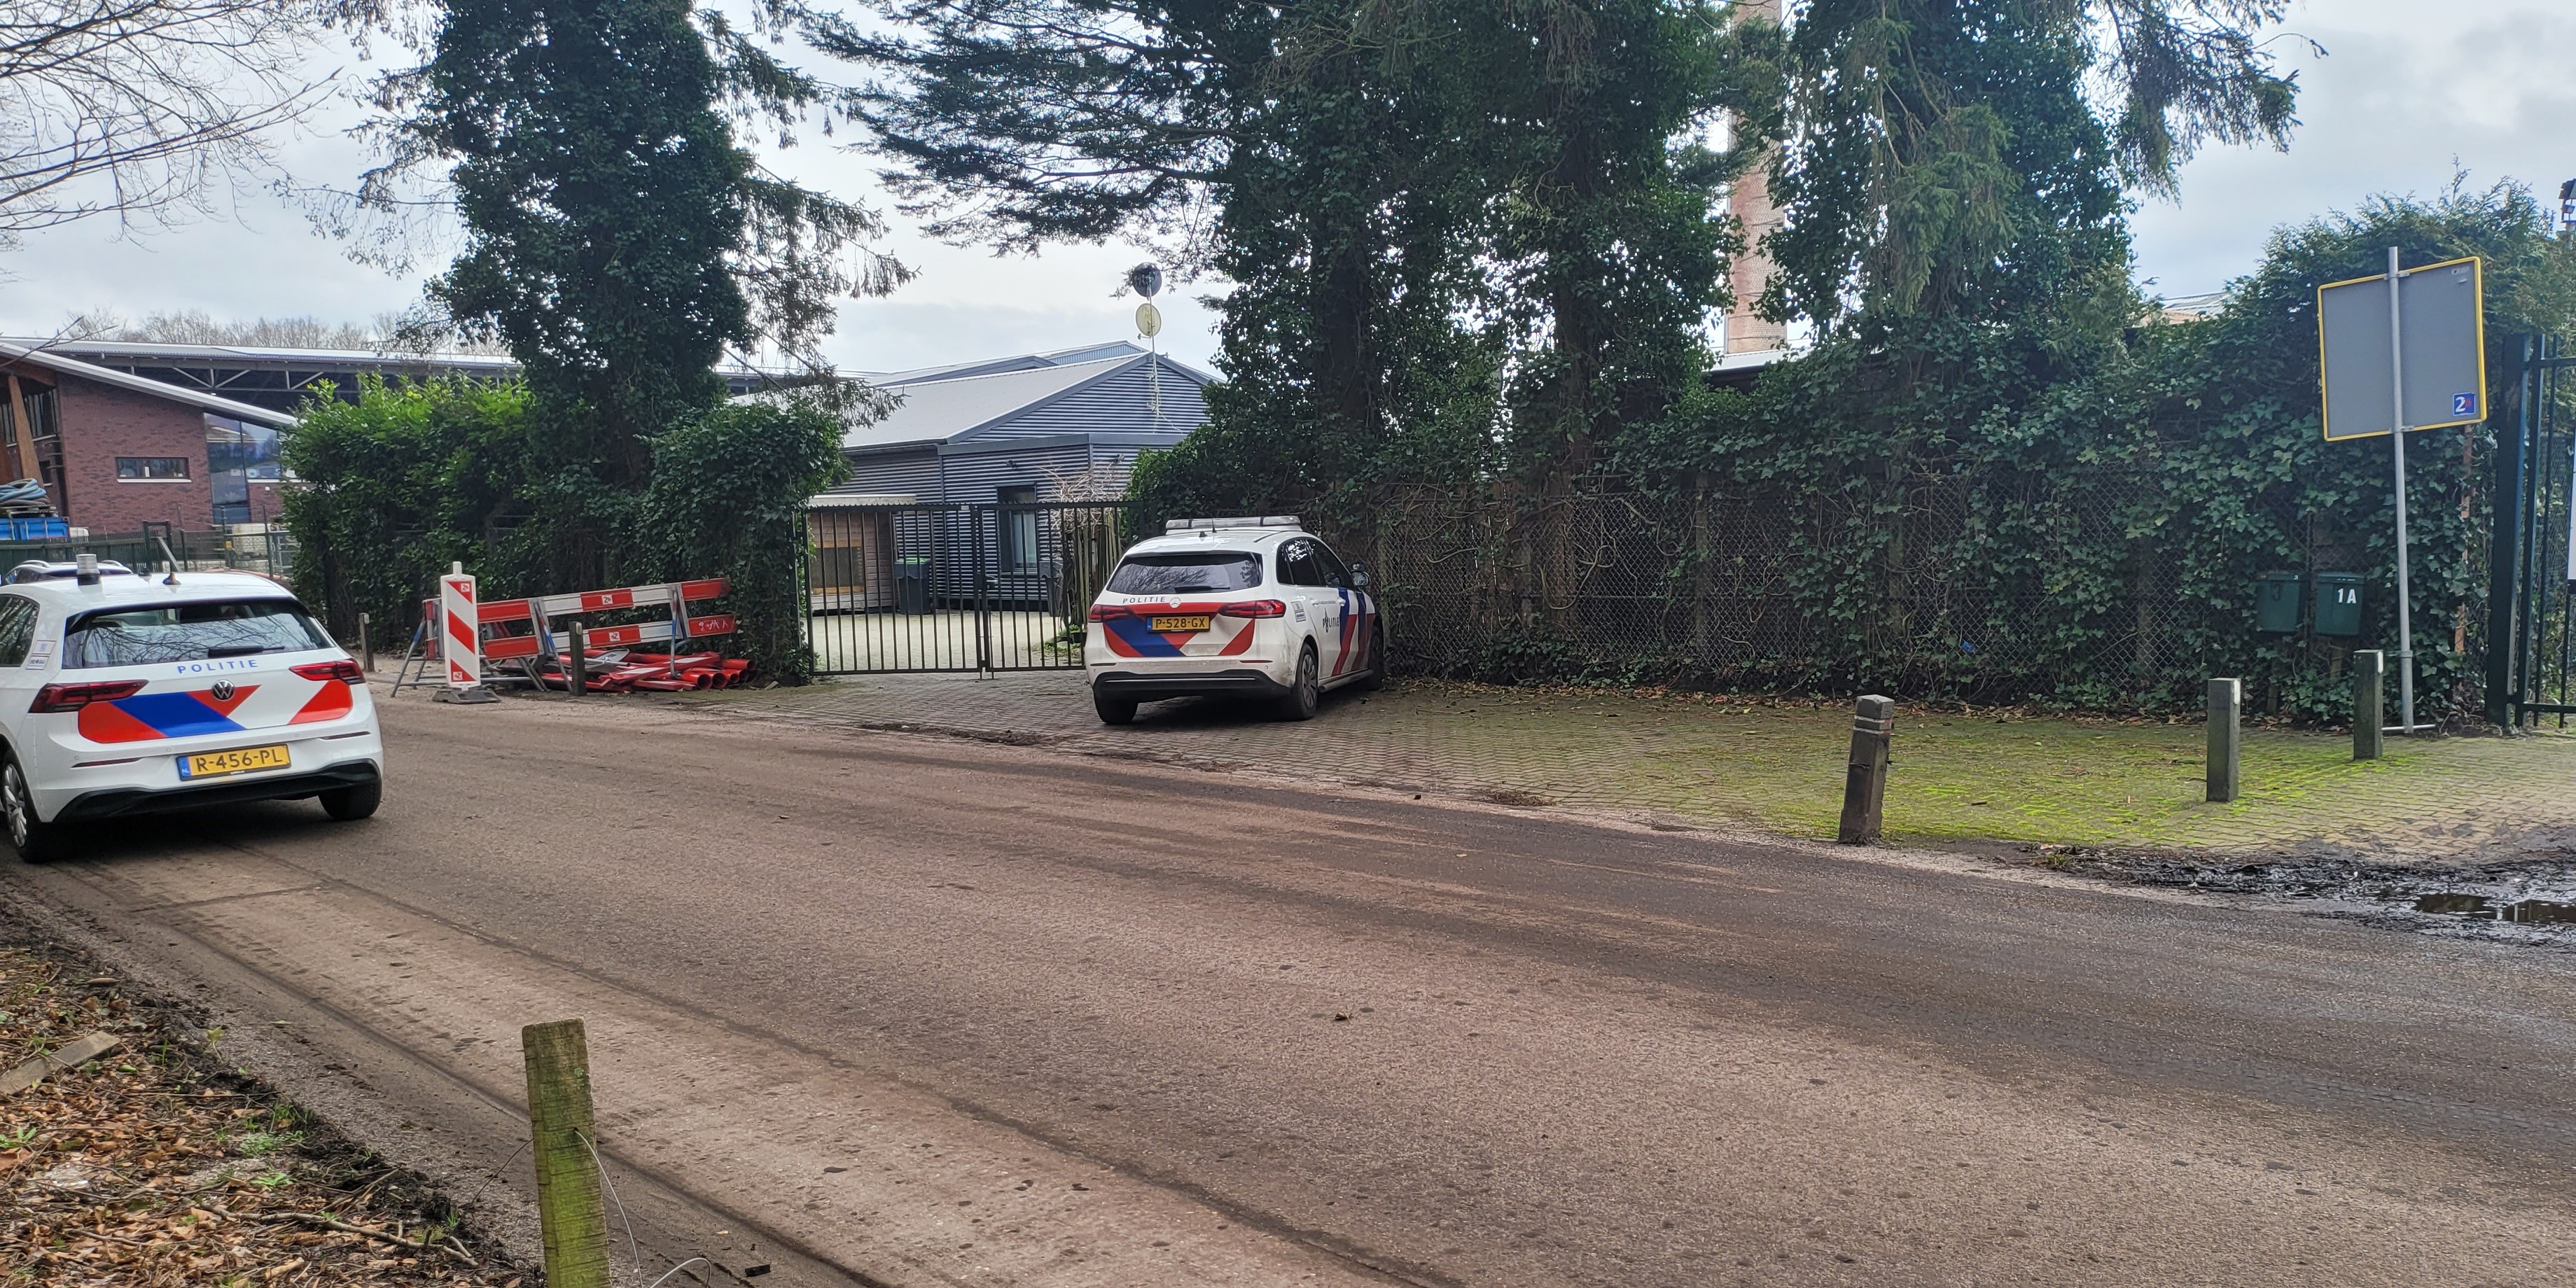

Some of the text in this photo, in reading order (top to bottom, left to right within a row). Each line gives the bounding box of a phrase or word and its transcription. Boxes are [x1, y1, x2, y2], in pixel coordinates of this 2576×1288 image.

[1155, 617, 1205, 629] P-528-GX
[177, 659, 258, 674] POLITIE
[195, 749, 283, 772] R-456-PL
